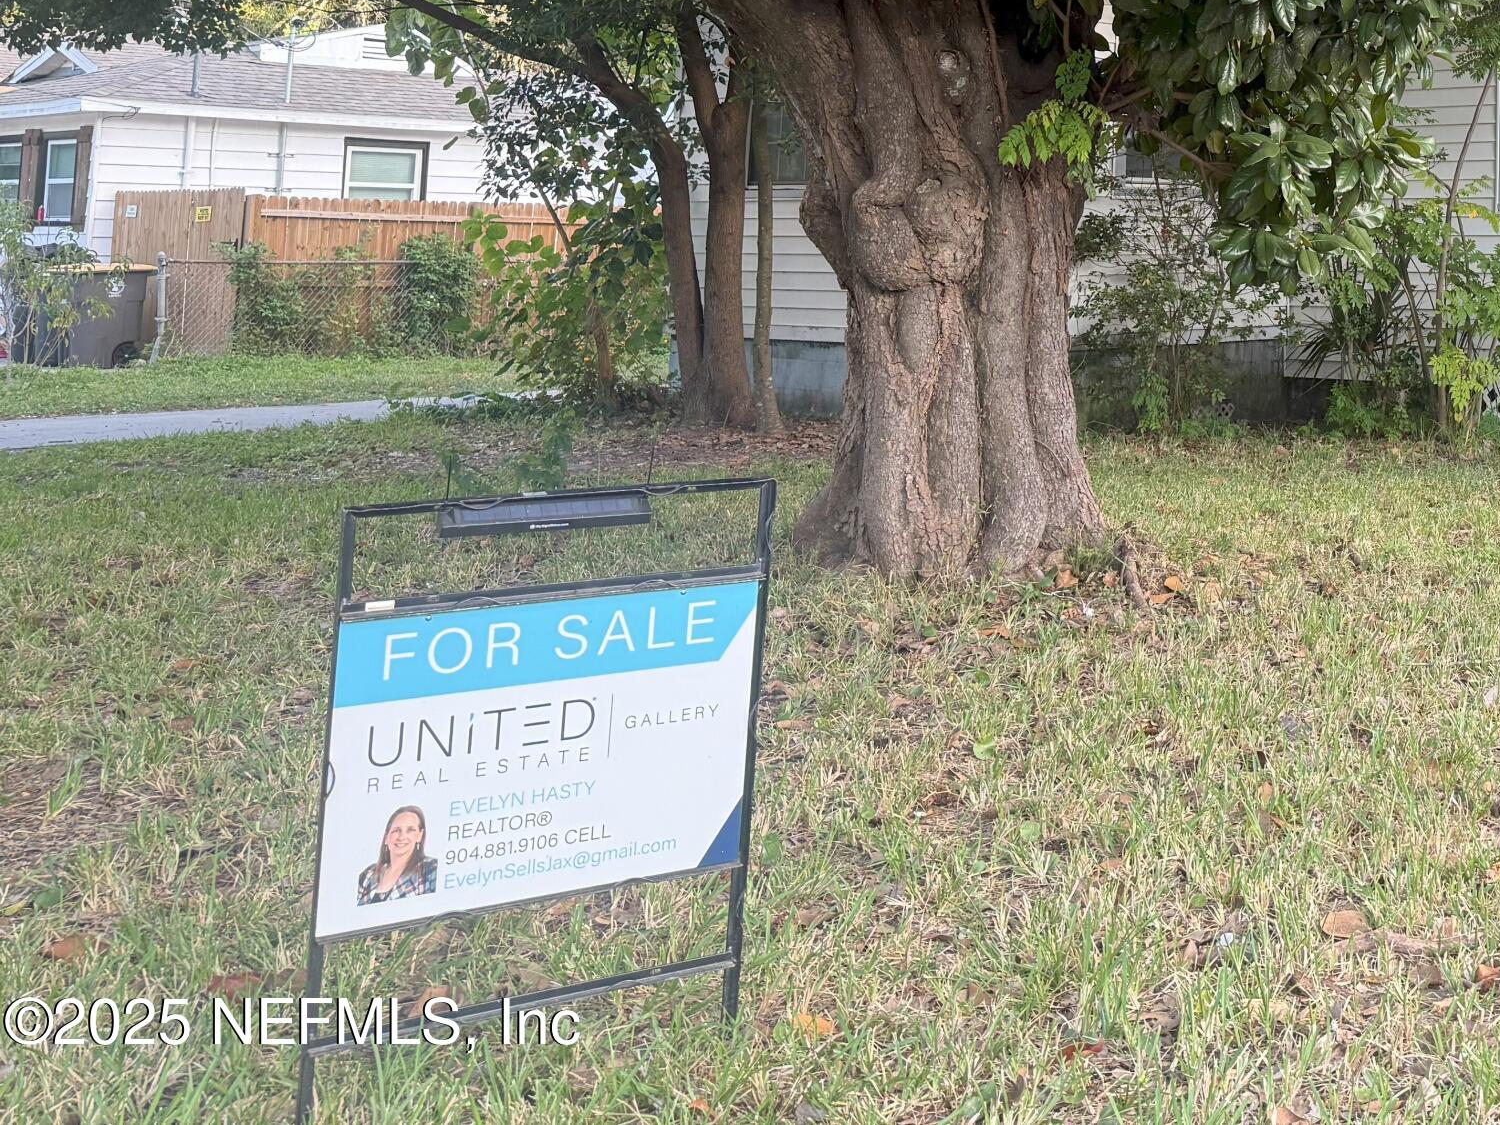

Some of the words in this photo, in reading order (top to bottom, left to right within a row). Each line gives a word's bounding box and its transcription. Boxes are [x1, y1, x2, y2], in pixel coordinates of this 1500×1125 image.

[382, 621, 521, 681] FOR
[554, 600, 717, 660] SALE
[624, 703, 720, 730] GALLERY
[367, 768, 449, 794] REAL
[475, 746, 590, 777] ESTATE
[449, 791, 525, 817] EVELYN
[531, 779, 597, 804] HASTY
[443, 837, 678, 890] EvelynSellsJax@gmail.com
[445, 833, 558, 865] 904.881.9106
[564, 823, 611, 845] CELL
